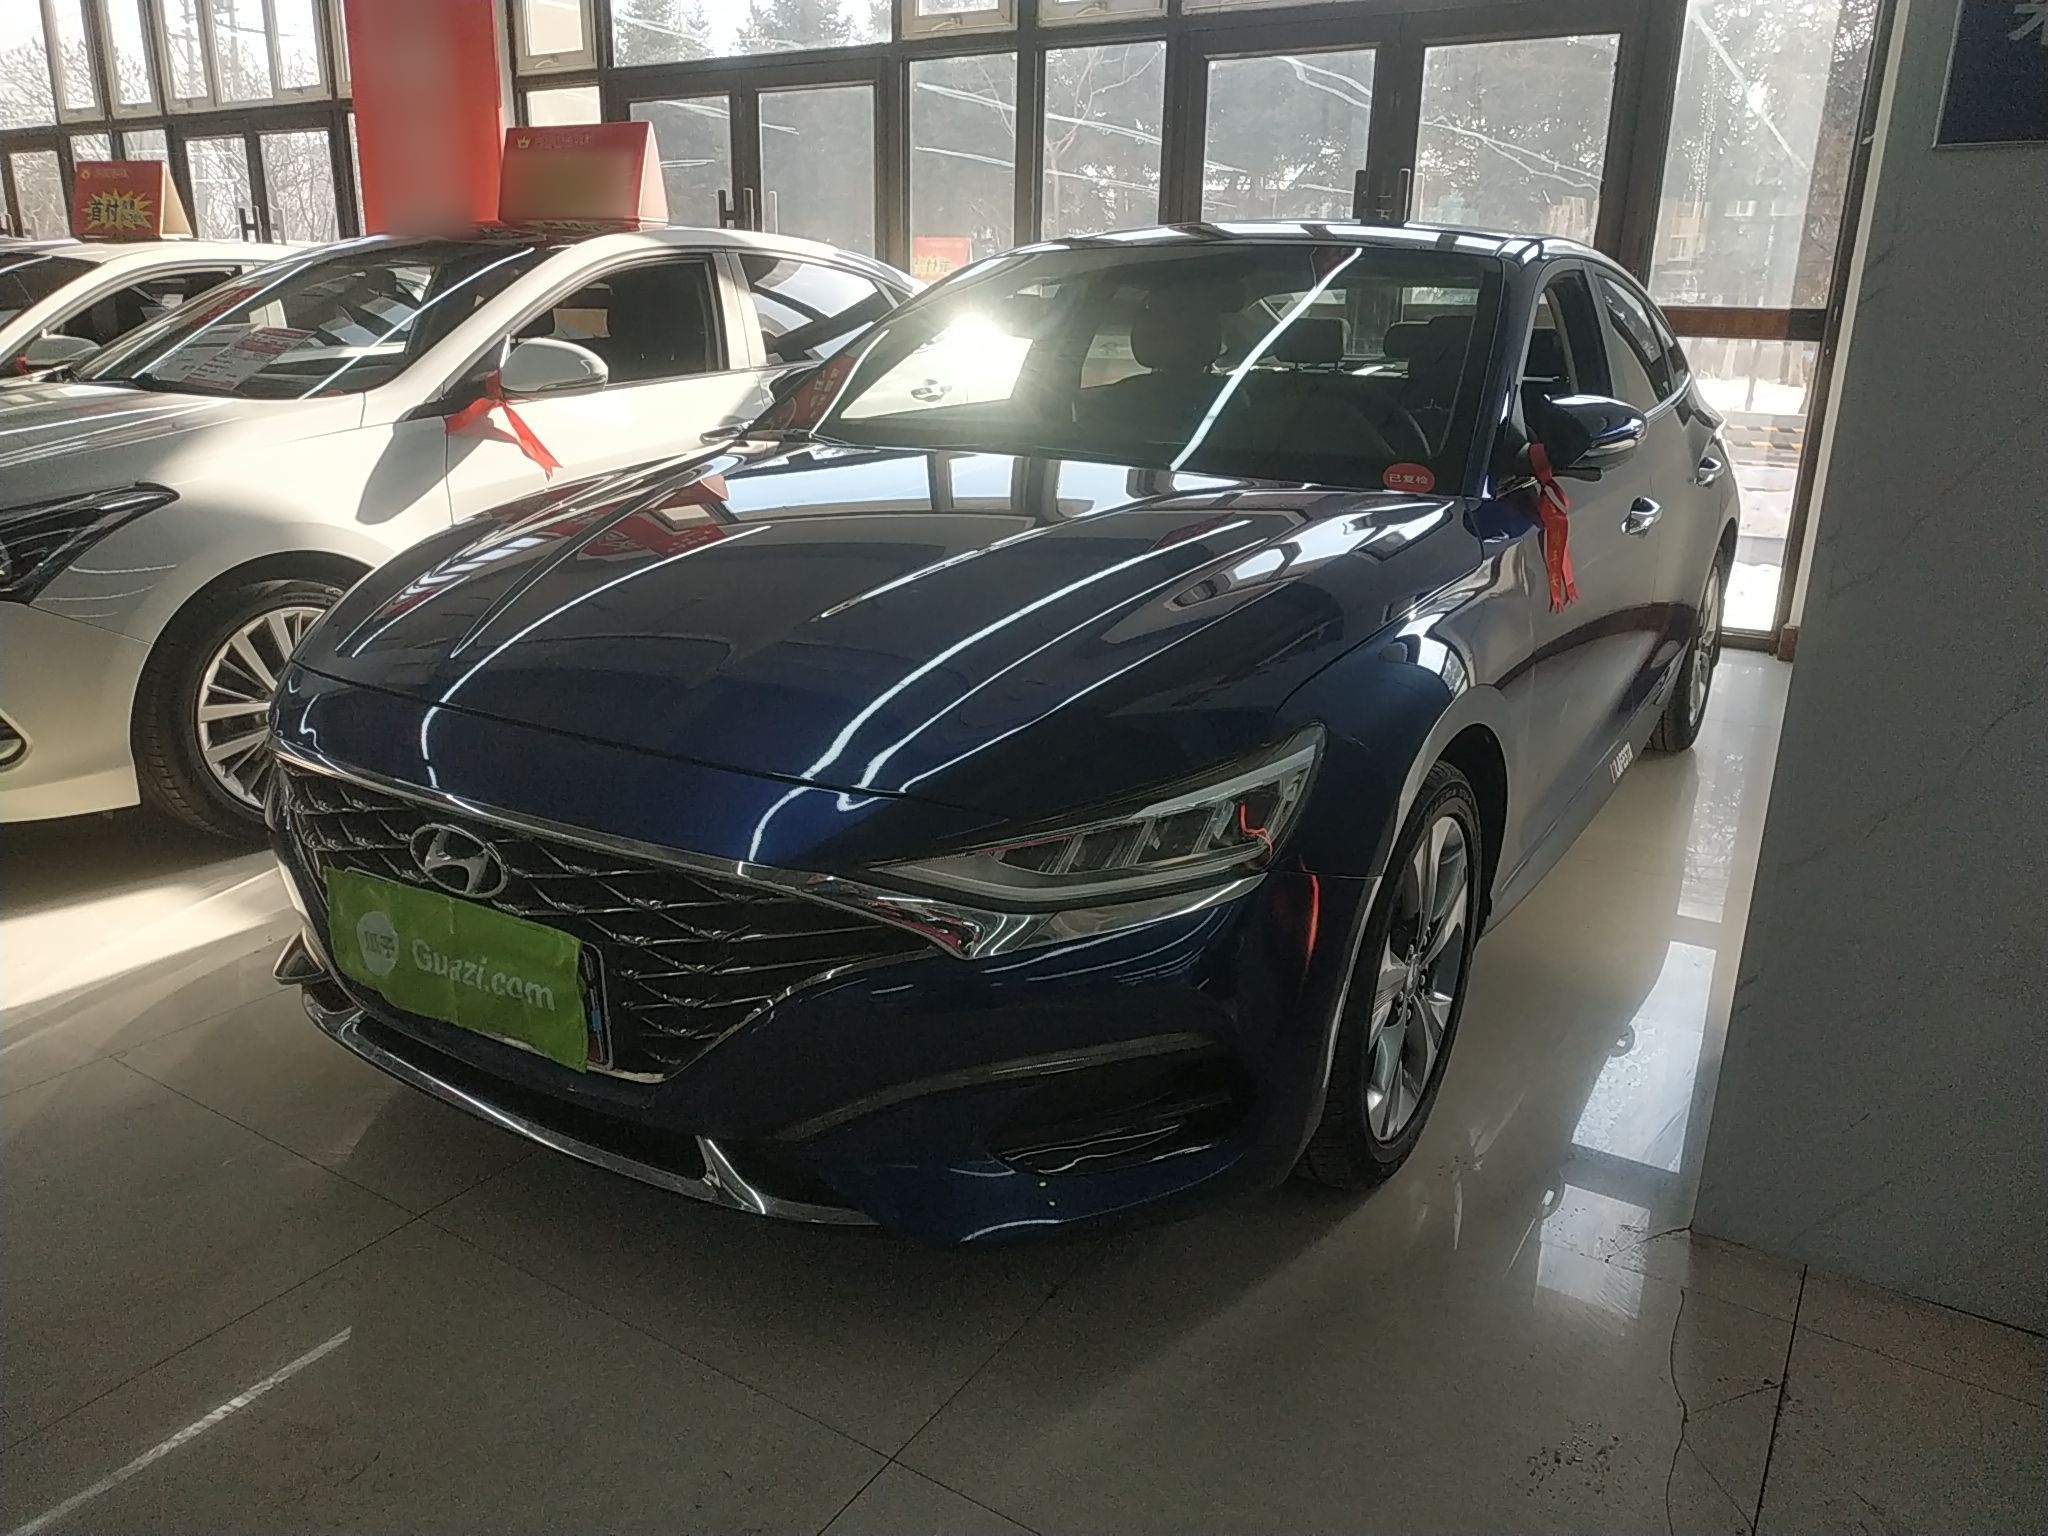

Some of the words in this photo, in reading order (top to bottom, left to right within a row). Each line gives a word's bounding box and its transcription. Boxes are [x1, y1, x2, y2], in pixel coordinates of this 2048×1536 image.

[1388, 473, 1428, 485] 已复检
[411, 940, 555, 1010] Guazi.com
